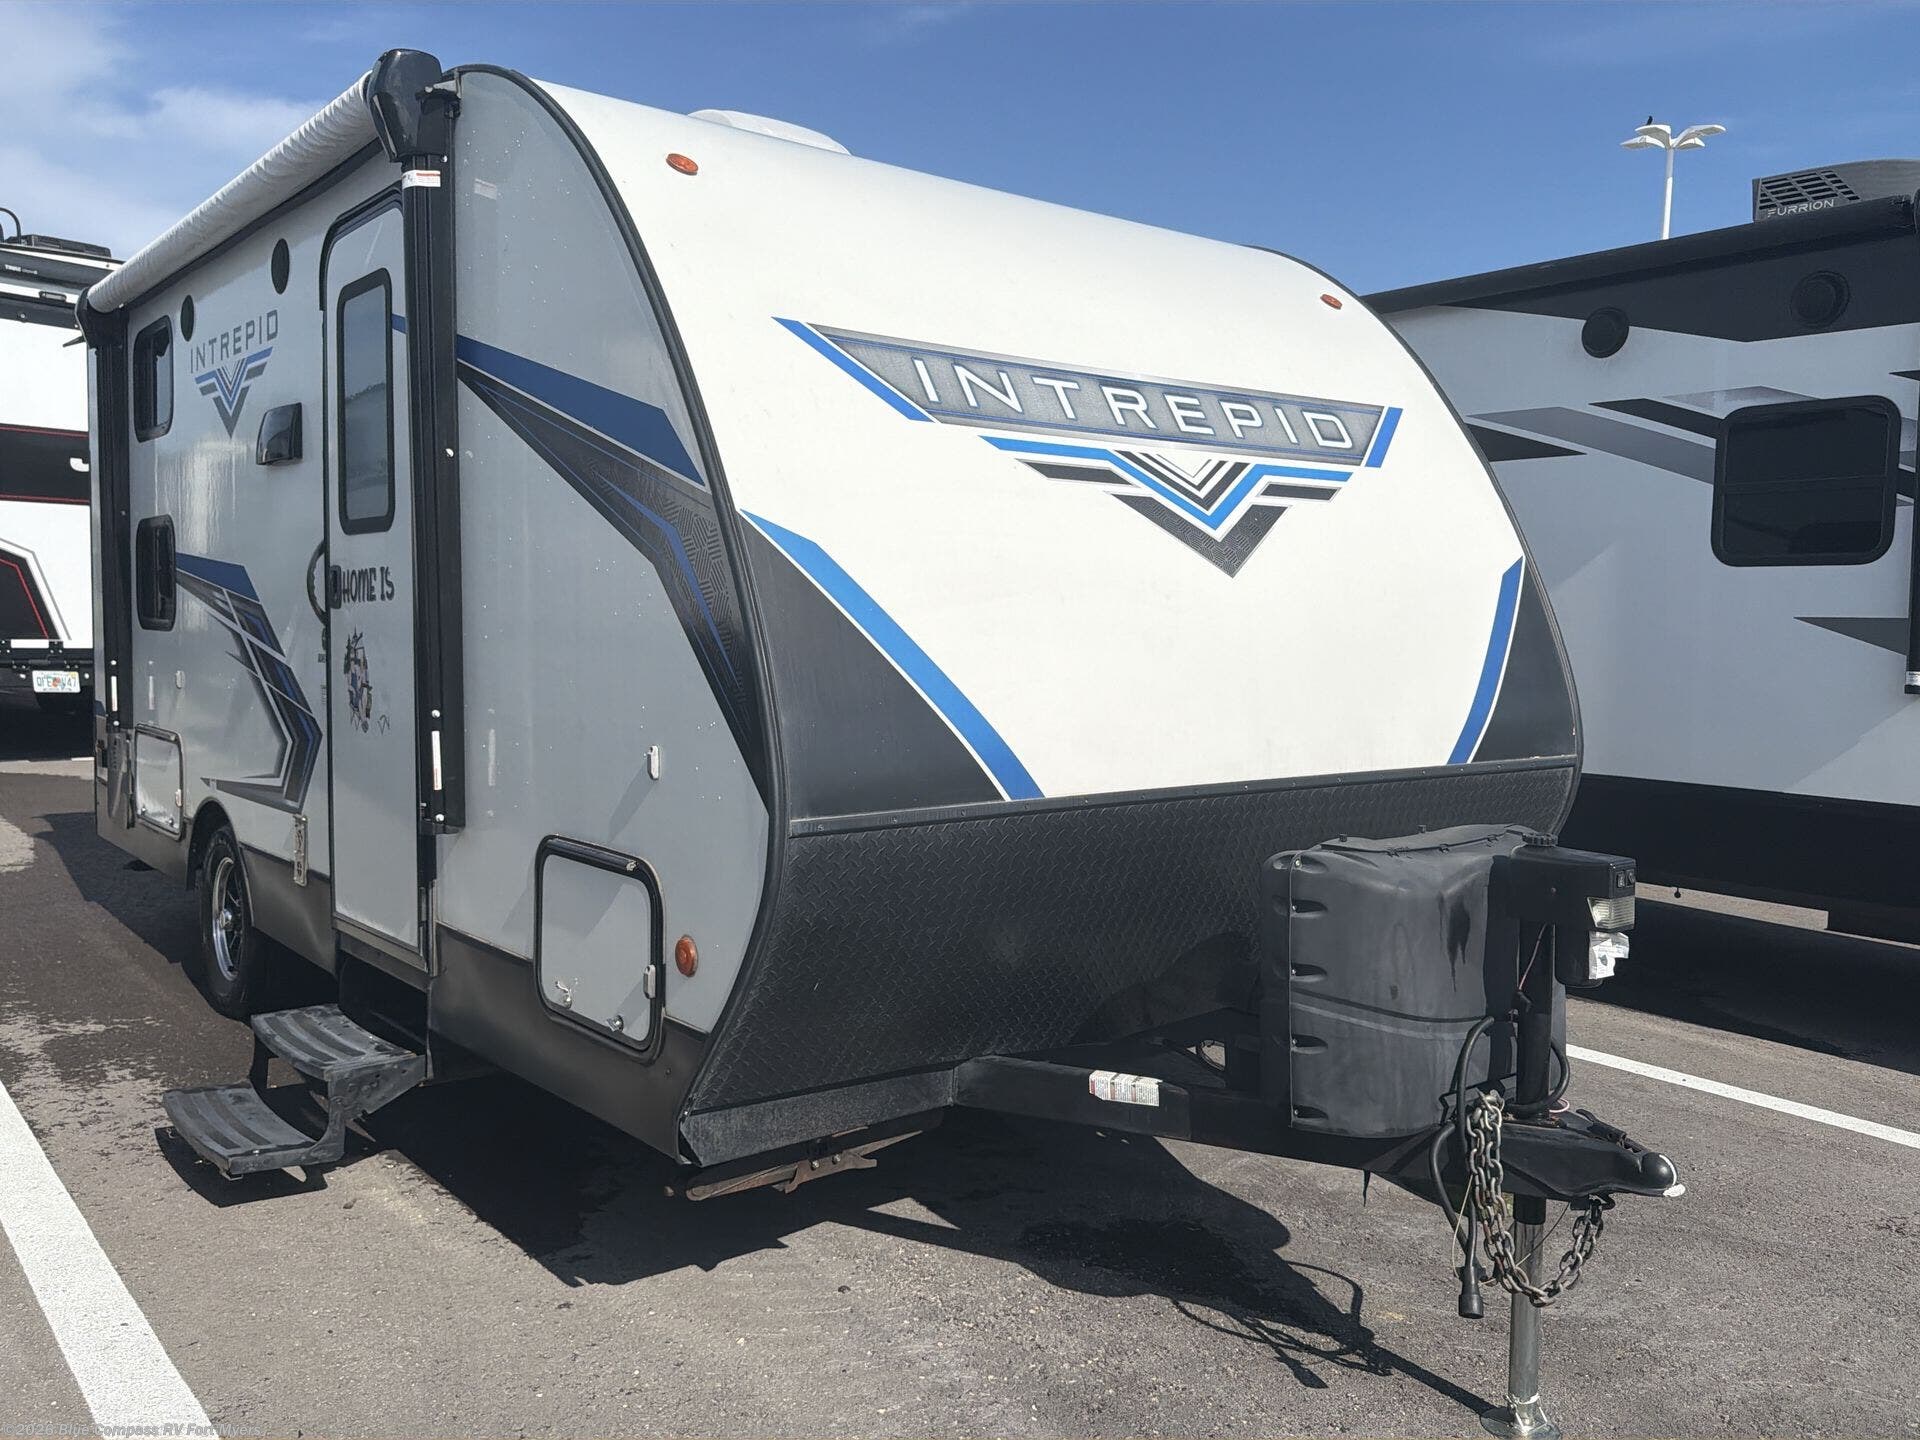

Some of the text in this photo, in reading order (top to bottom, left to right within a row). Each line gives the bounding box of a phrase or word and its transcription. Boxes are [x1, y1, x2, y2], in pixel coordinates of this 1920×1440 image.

[1767, 199, 1834, 218] FURRION
[190, 309, 279, 374] INTREPID
[911, 356, 1354, 449] INTREPID
[342, 566, 395, 604] HOME IS
